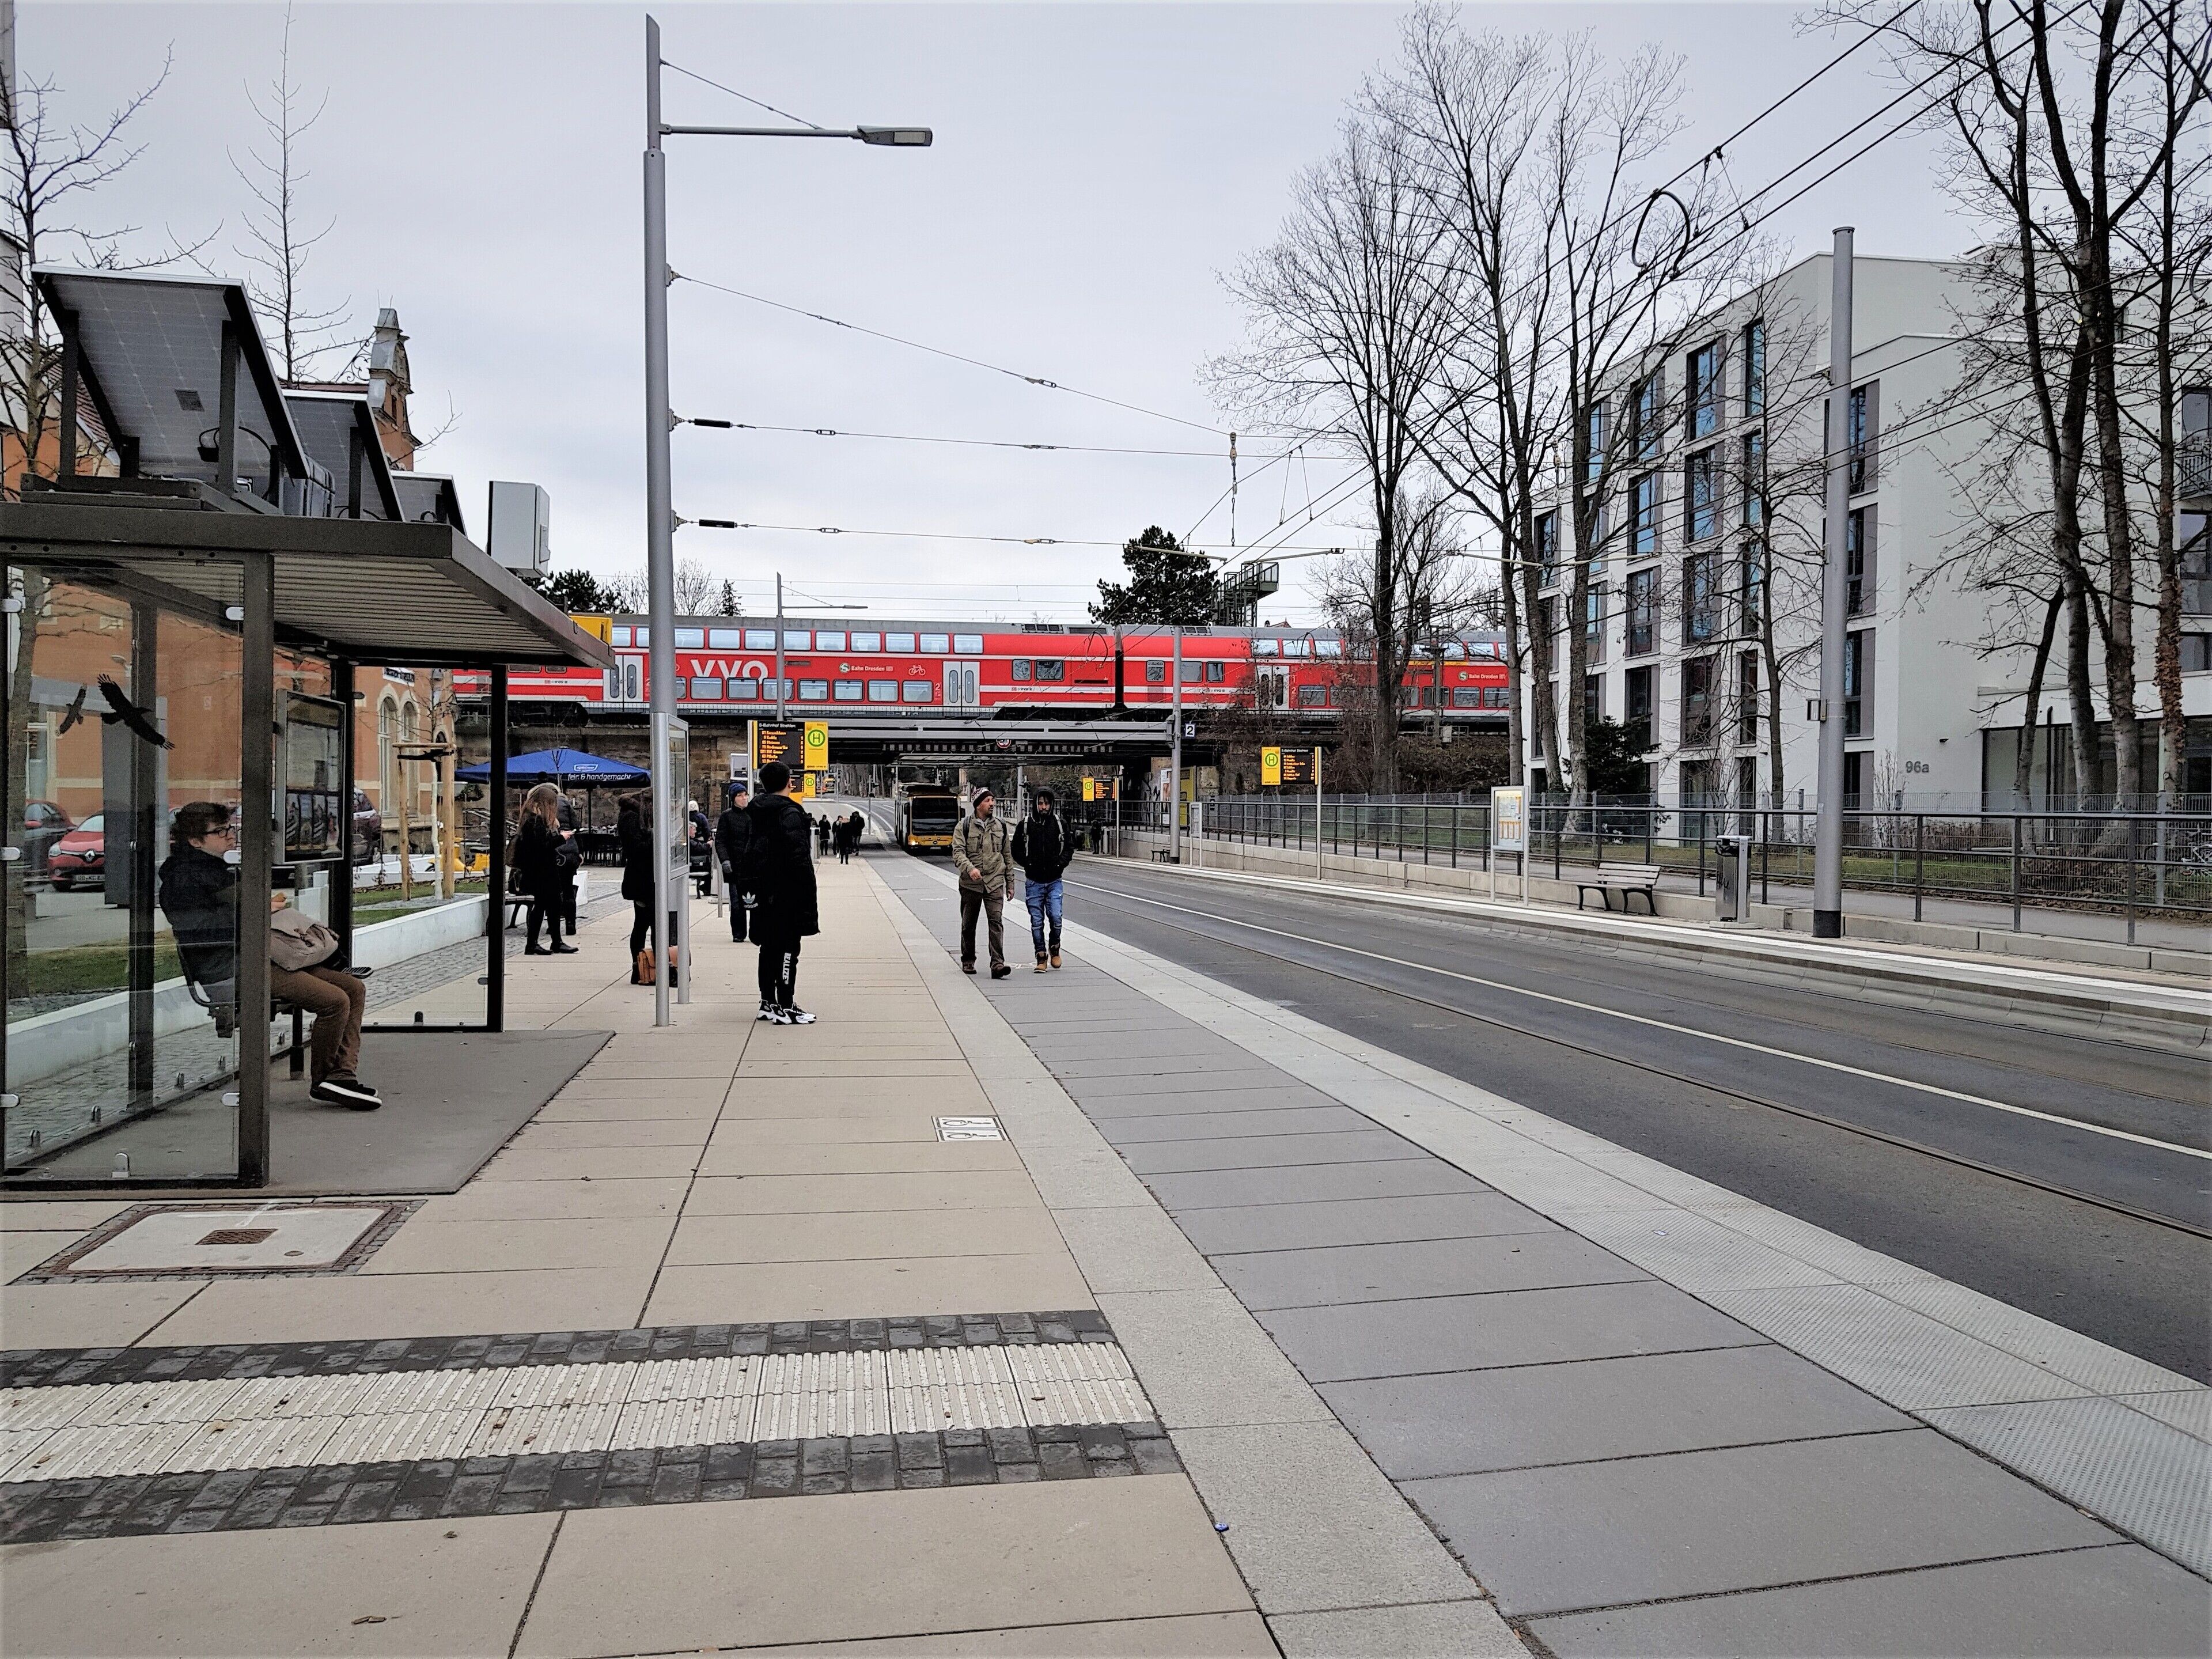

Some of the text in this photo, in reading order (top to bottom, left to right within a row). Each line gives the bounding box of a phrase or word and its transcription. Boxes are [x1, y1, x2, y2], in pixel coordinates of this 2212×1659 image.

[935, 683, 941, 691] 2
[1187, 725, 1194, 736] 2
[813, 733, 821, 743] H
[1906, 760, 1930, 773] 96a
[586, 773, 632, 782] handgemacht
